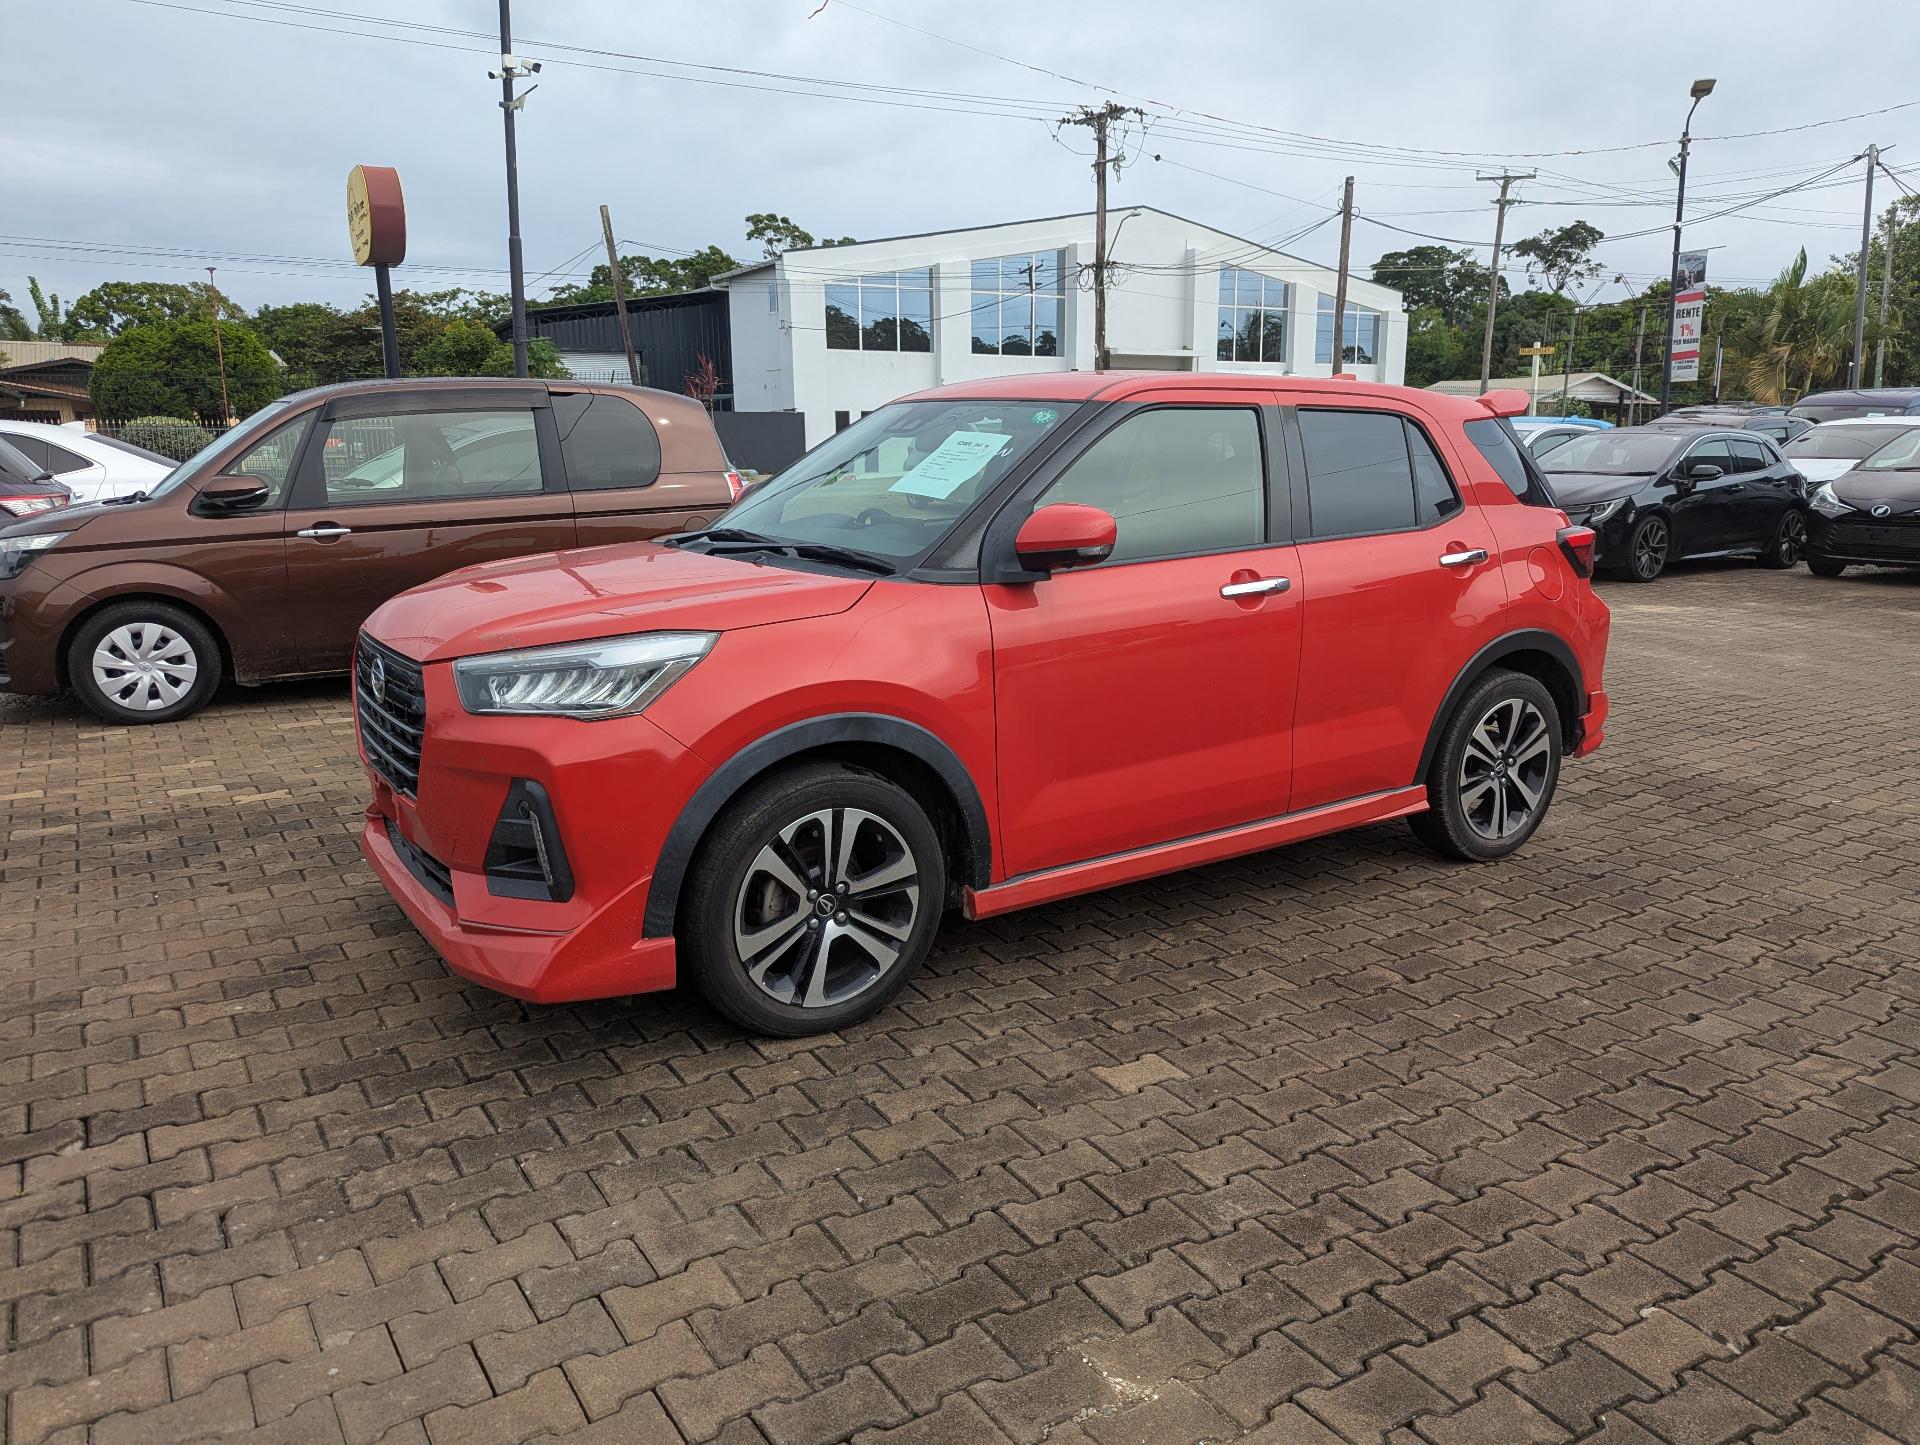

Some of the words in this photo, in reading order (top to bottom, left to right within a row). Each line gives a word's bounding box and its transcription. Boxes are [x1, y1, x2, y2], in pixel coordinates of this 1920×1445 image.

[1675, 306, 1701, 319] RENTE
[1680, 323, 1694, 337] 1%
[1683, 337, 1700, 345] MAAND
